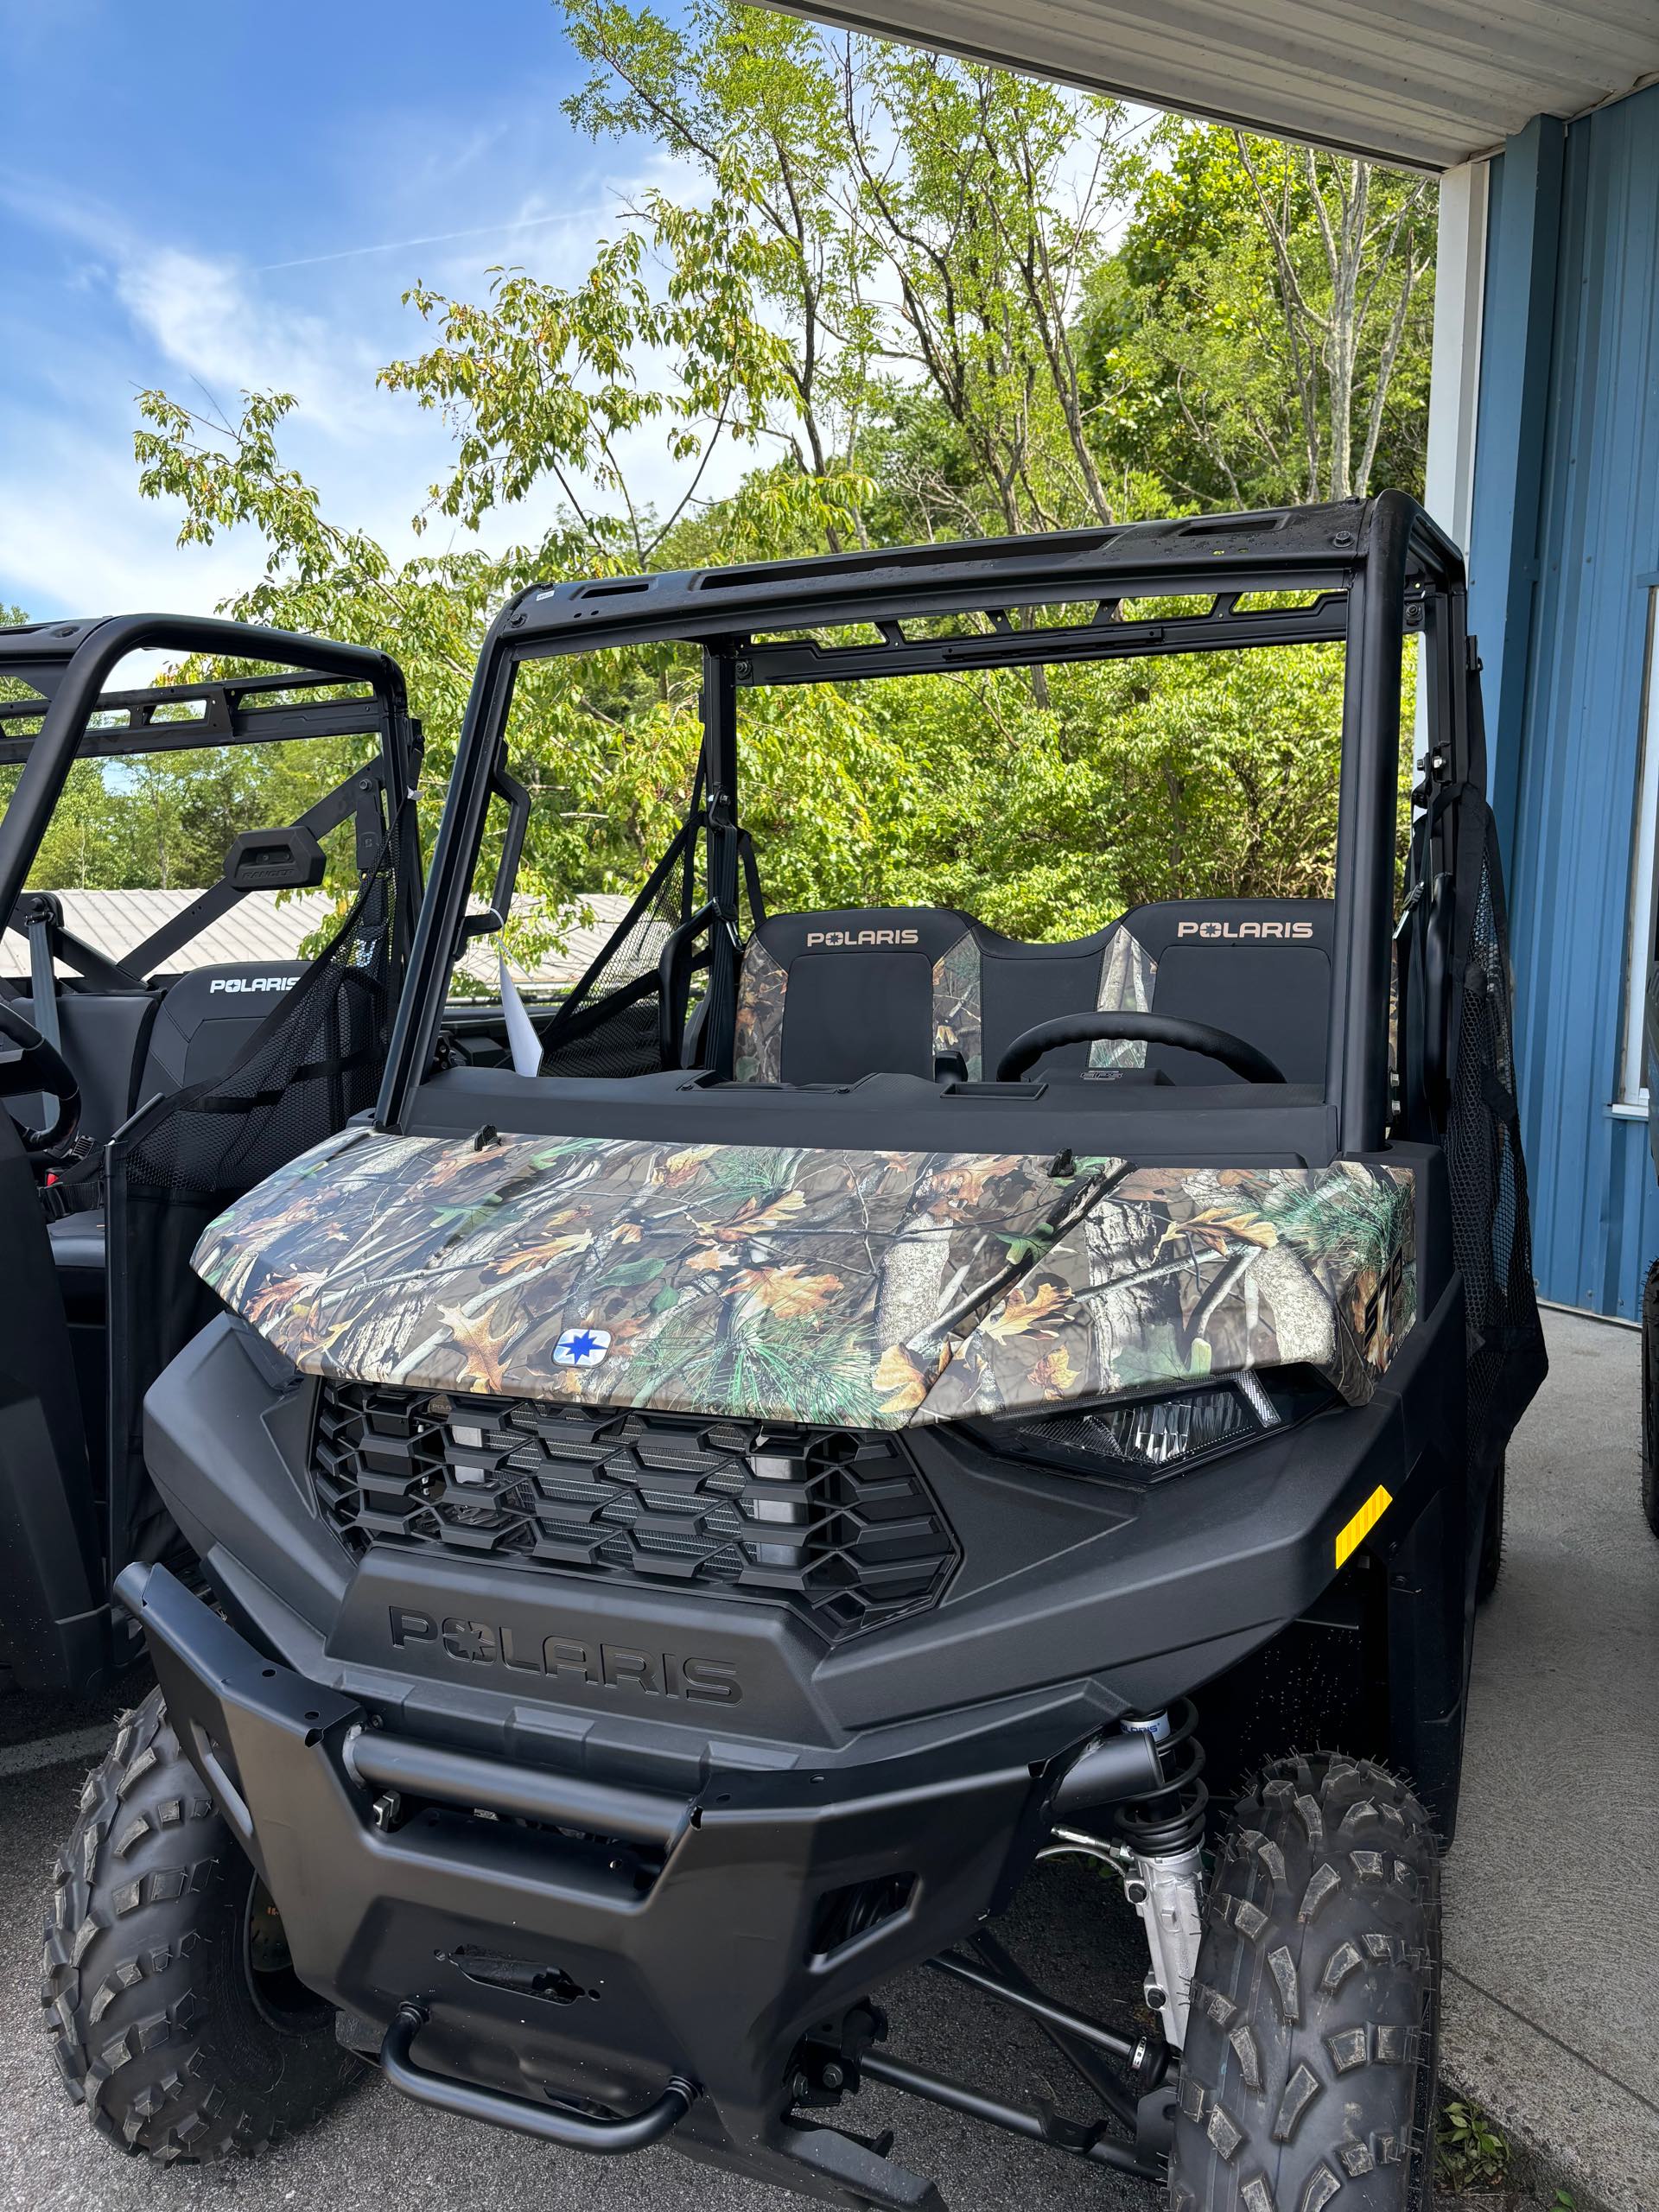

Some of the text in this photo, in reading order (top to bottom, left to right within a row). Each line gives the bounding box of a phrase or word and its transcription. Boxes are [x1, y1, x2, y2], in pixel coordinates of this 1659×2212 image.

[1178, 922, 1313, 938] POLARIS
[807, 930, 918, 947] POLARIS
[210, 977, 301, 993] POLARIS
[389, 1605, 743, 1707] POLARIS
